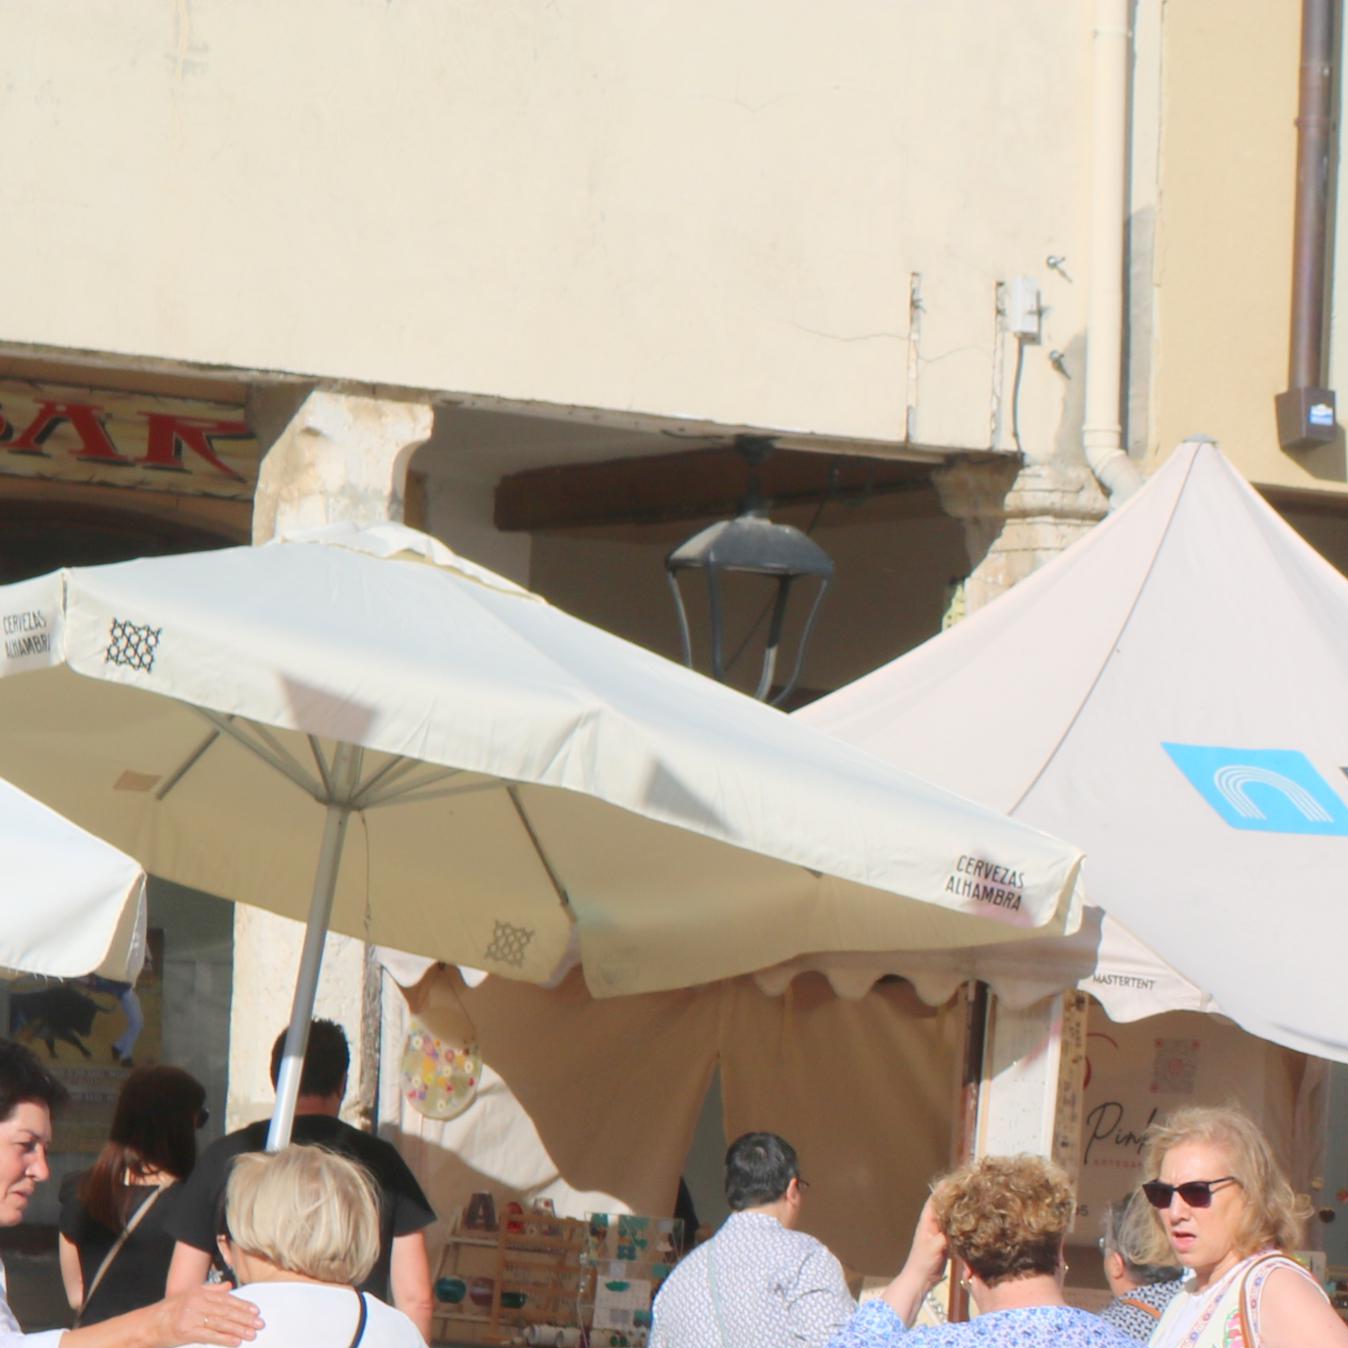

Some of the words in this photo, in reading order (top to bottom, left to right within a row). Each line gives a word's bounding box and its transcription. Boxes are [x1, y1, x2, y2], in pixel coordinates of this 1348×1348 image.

[0, 395, 254, 484] AR
[956, 855, 1024, 889] CERVEZAS
[945, 875, 1023, 912] ALHAMBRA
